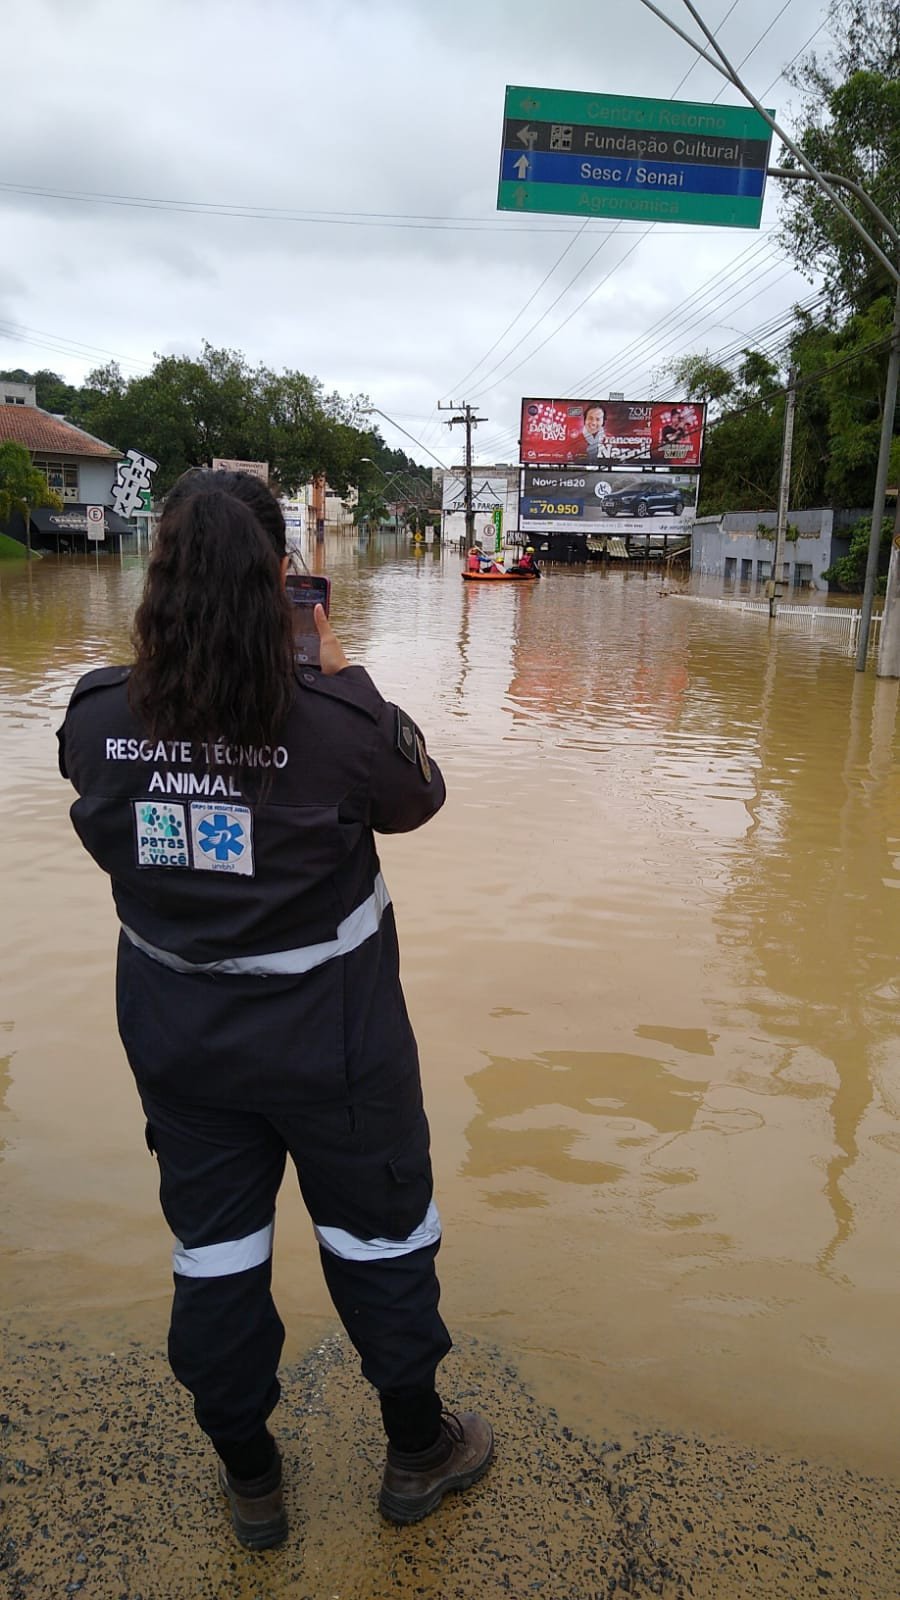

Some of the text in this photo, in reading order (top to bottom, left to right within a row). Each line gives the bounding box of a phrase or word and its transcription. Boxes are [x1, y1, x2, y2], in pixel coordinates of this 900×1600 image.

[586, 101, 645, 122] Centro
[658, 109, 726, 129] Retorno
[584, 132, 739, 160] Fundação Cultural
[580, 163, 684, 186] Sesc / Senai
[532, 477, 586, 488] Novo HB20
[93, 510, 99, 520] E
[540, 503, 579, 515] 70.950
[106, 736, 288, 768] RESGATE TÉCNICO
[148, 772, 242, 797] ANIMAL
